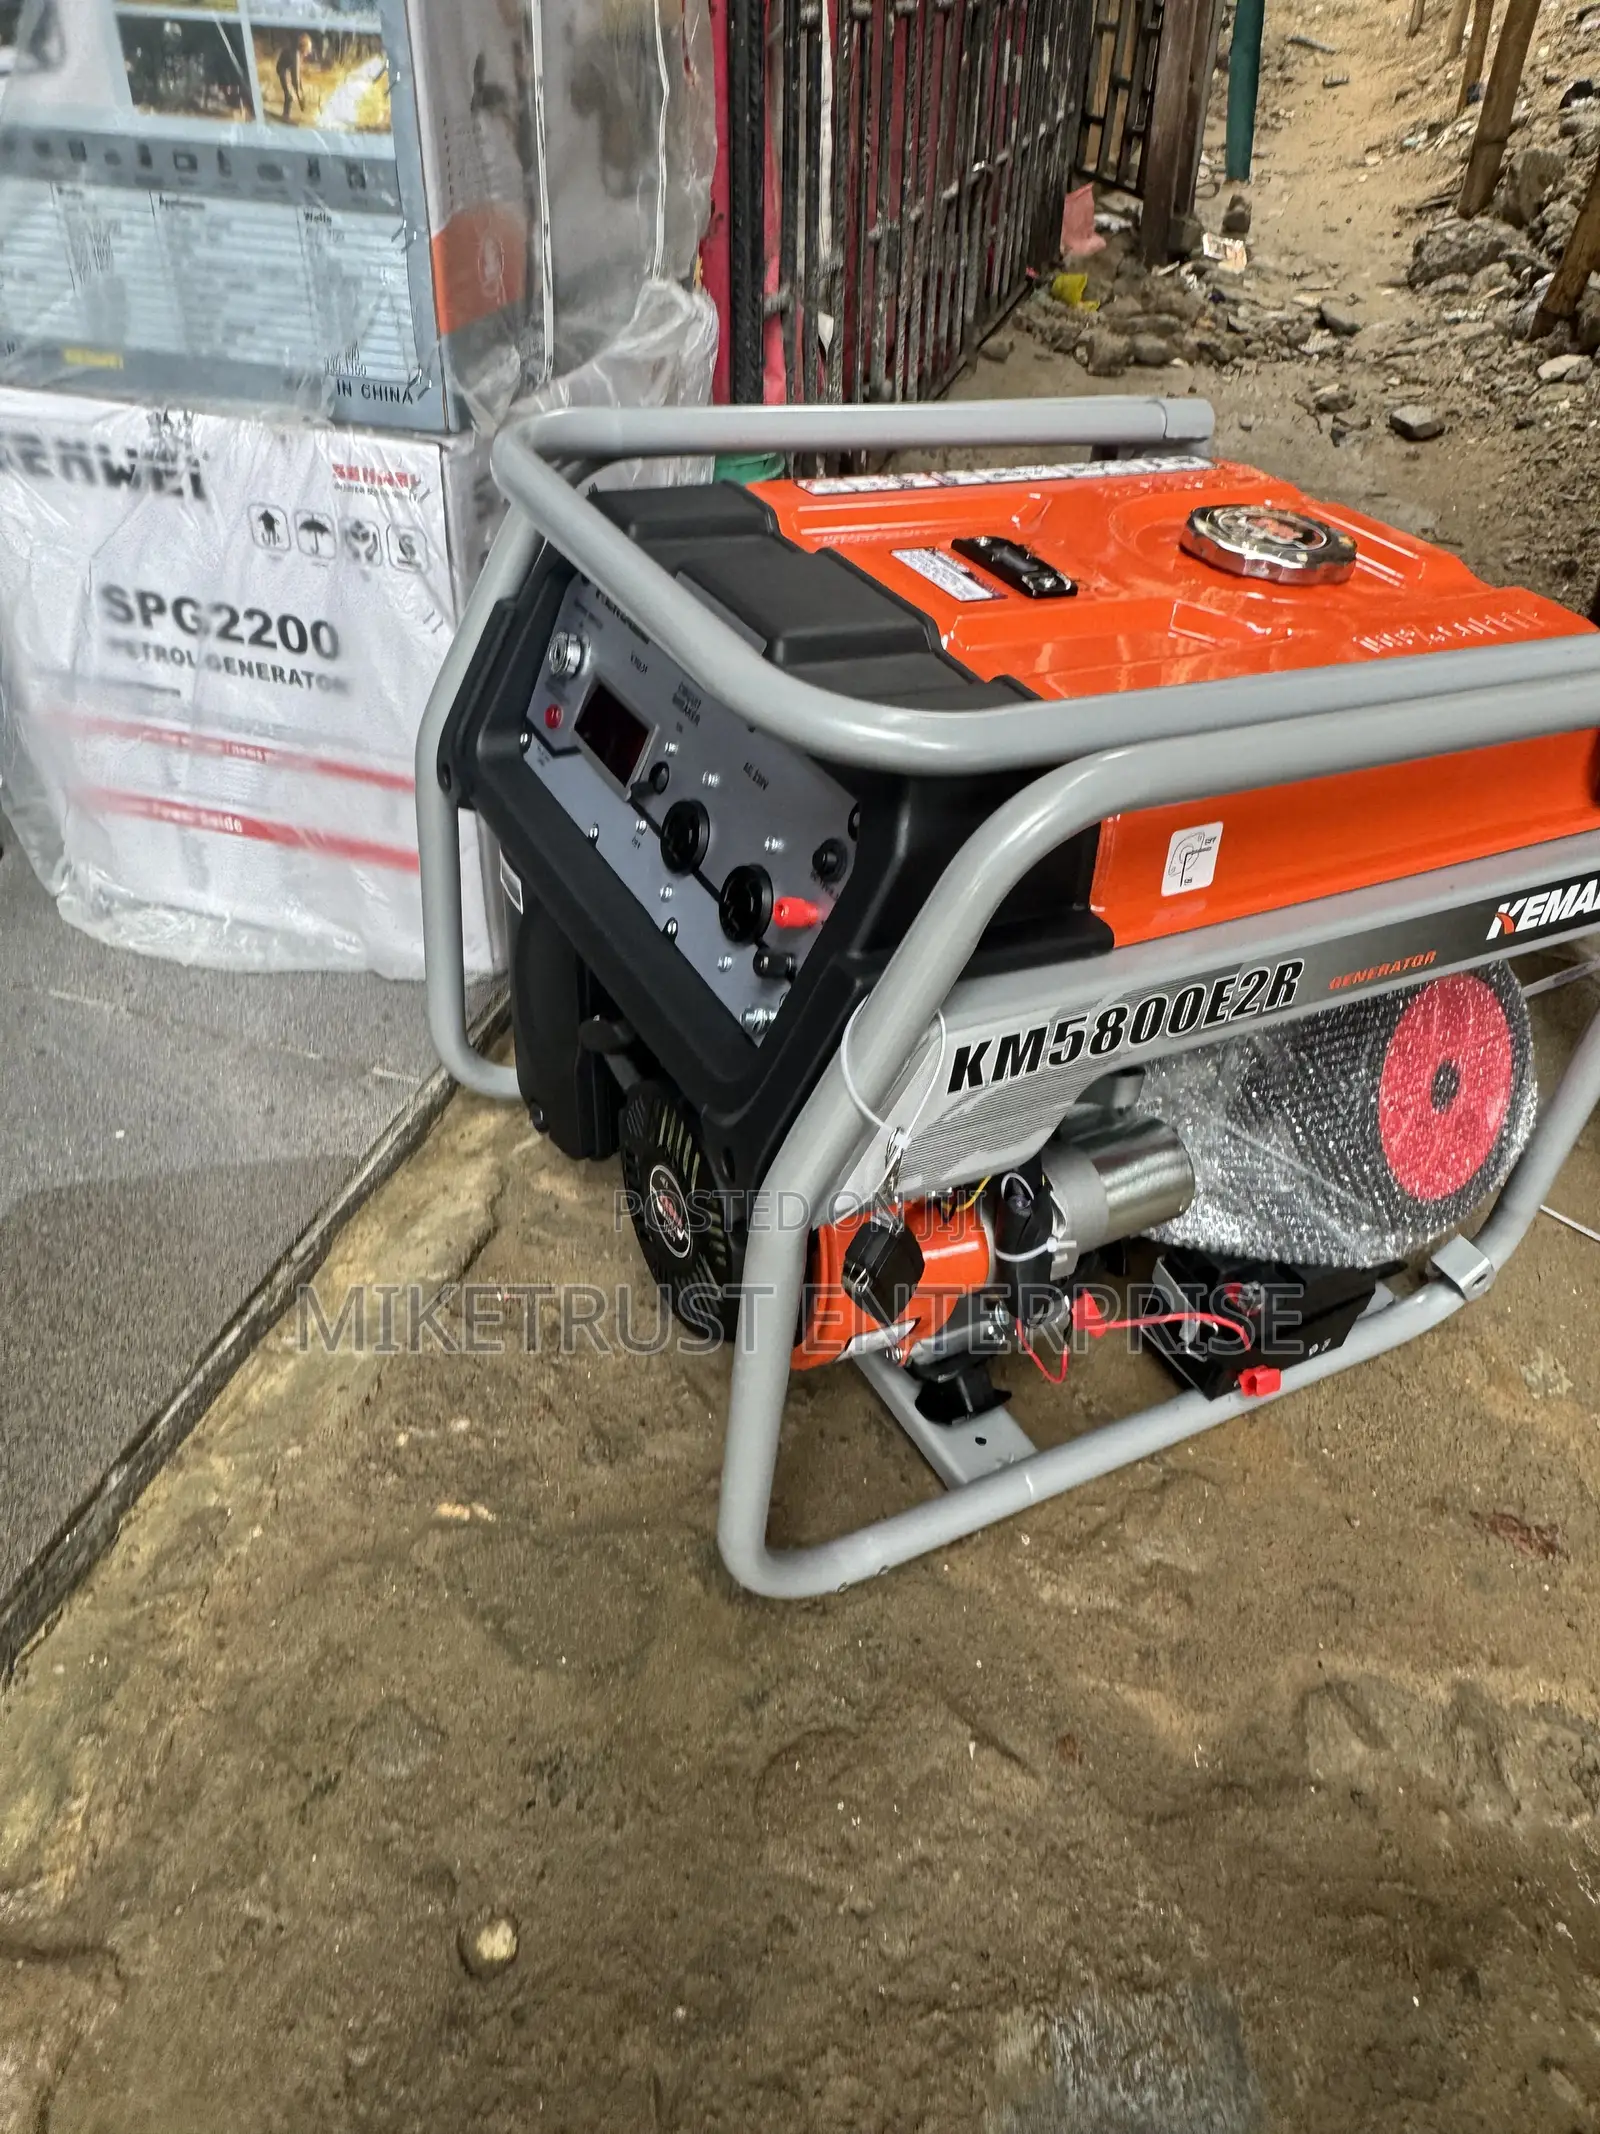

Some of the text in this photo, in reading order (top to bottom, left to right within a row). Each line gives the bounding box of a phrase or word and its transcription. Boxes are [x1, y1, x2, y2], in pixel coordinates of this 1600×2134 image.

[336, 379, 413, 405] IN CHINA
[101, 584, 341, 661] SPG2200
[1328, 950, 1437, 990] GENERATOR
[946, 958, 1305, 1095] KM5800E2R
